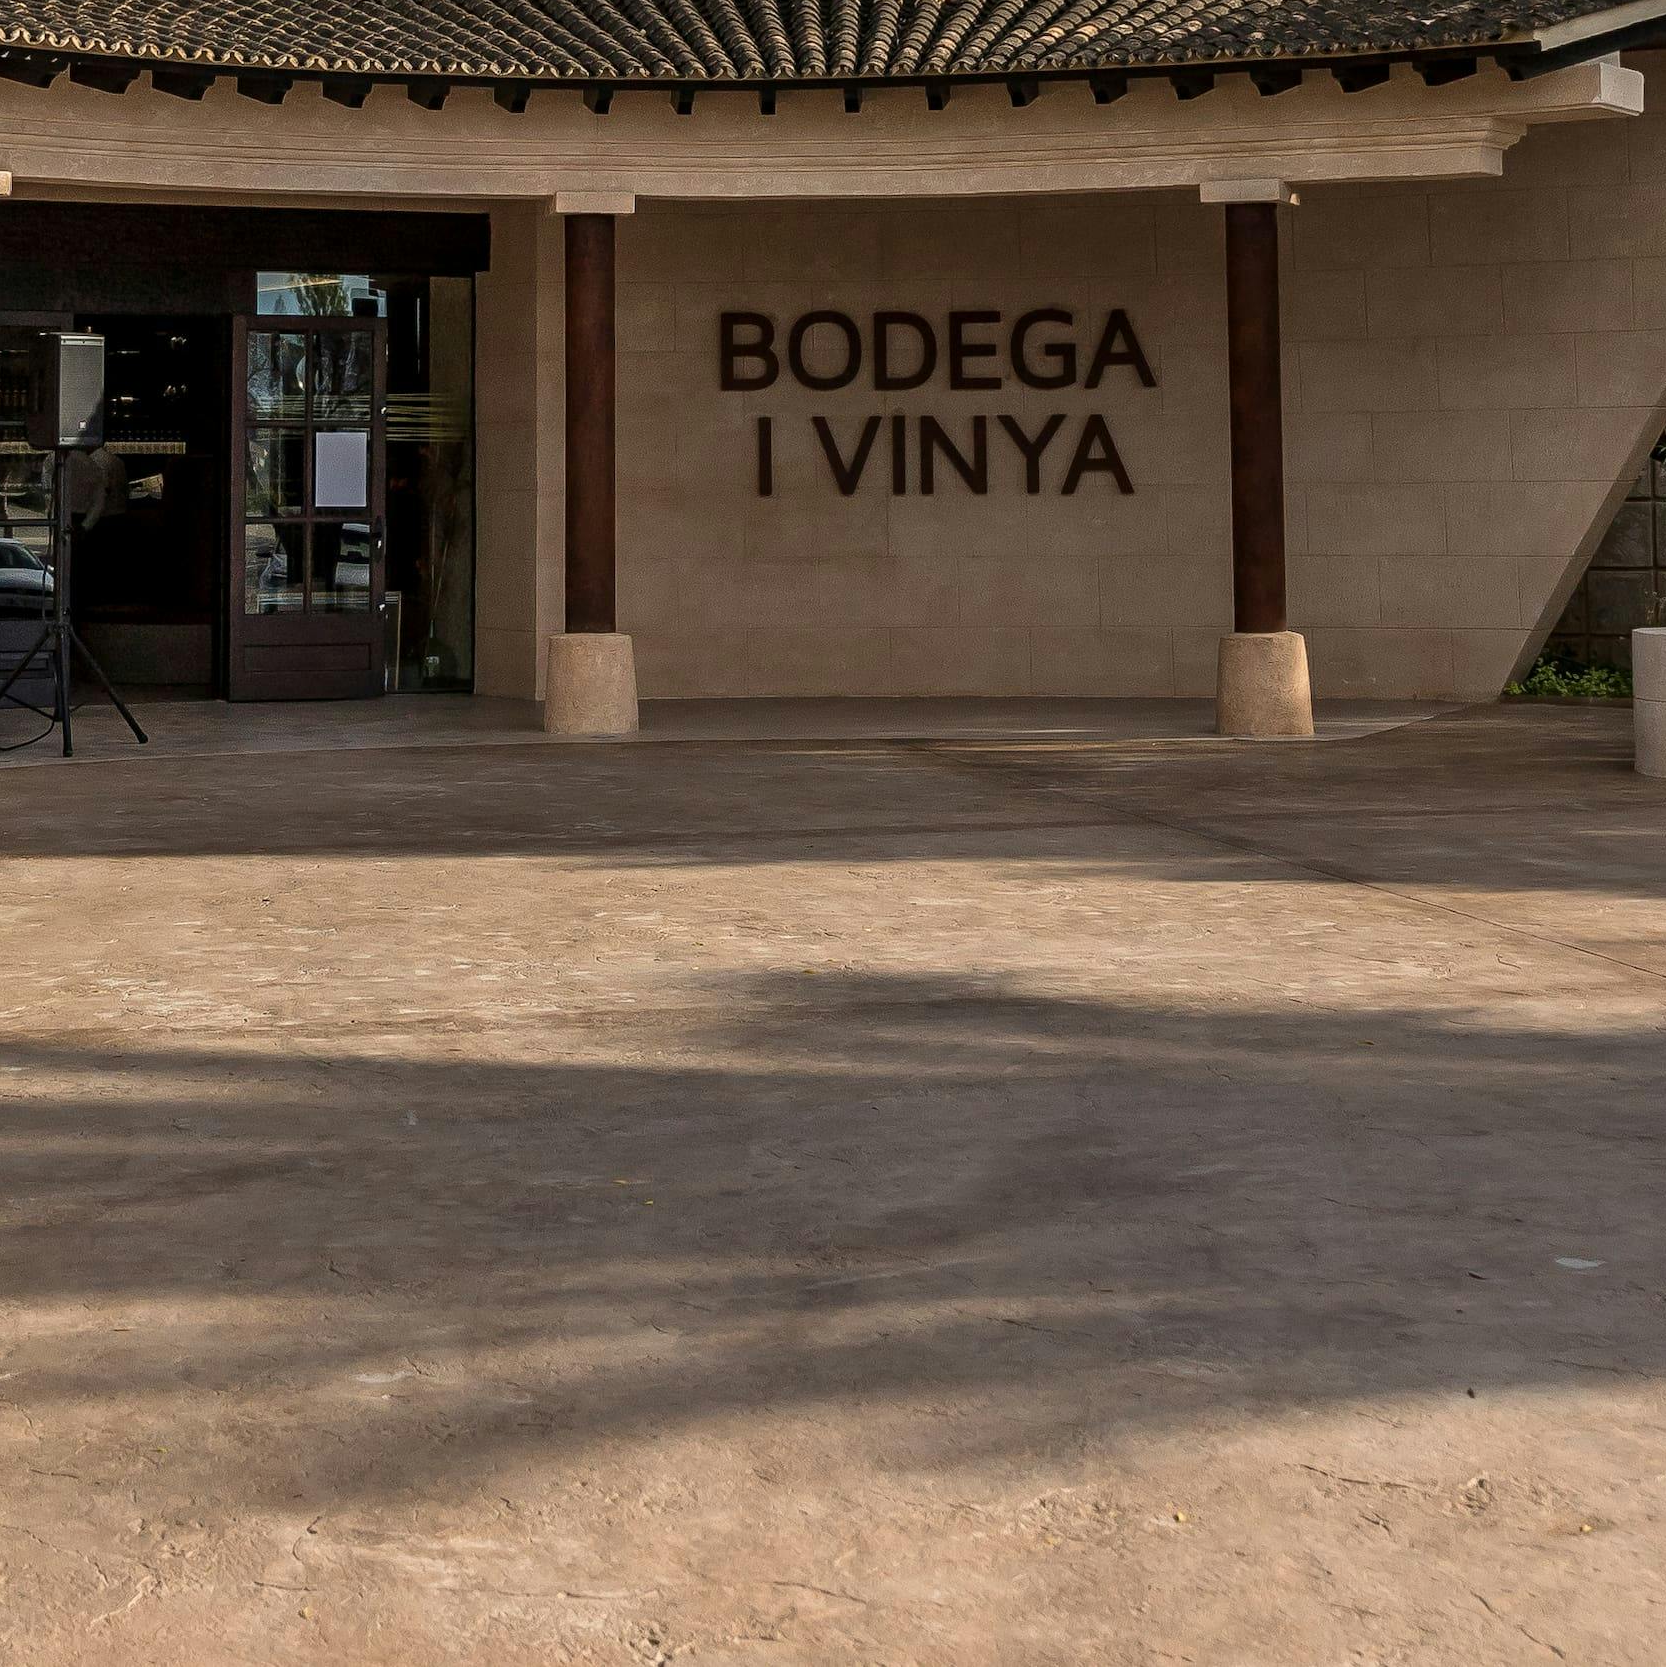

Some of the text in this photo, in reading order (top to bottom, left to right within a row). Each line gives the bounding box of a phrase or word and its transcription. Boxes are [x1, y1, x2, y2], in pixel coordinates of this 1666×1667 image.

[719, 309, 1157, 392] BODEGA
[757, 413, 1134, 497] I VINYA
